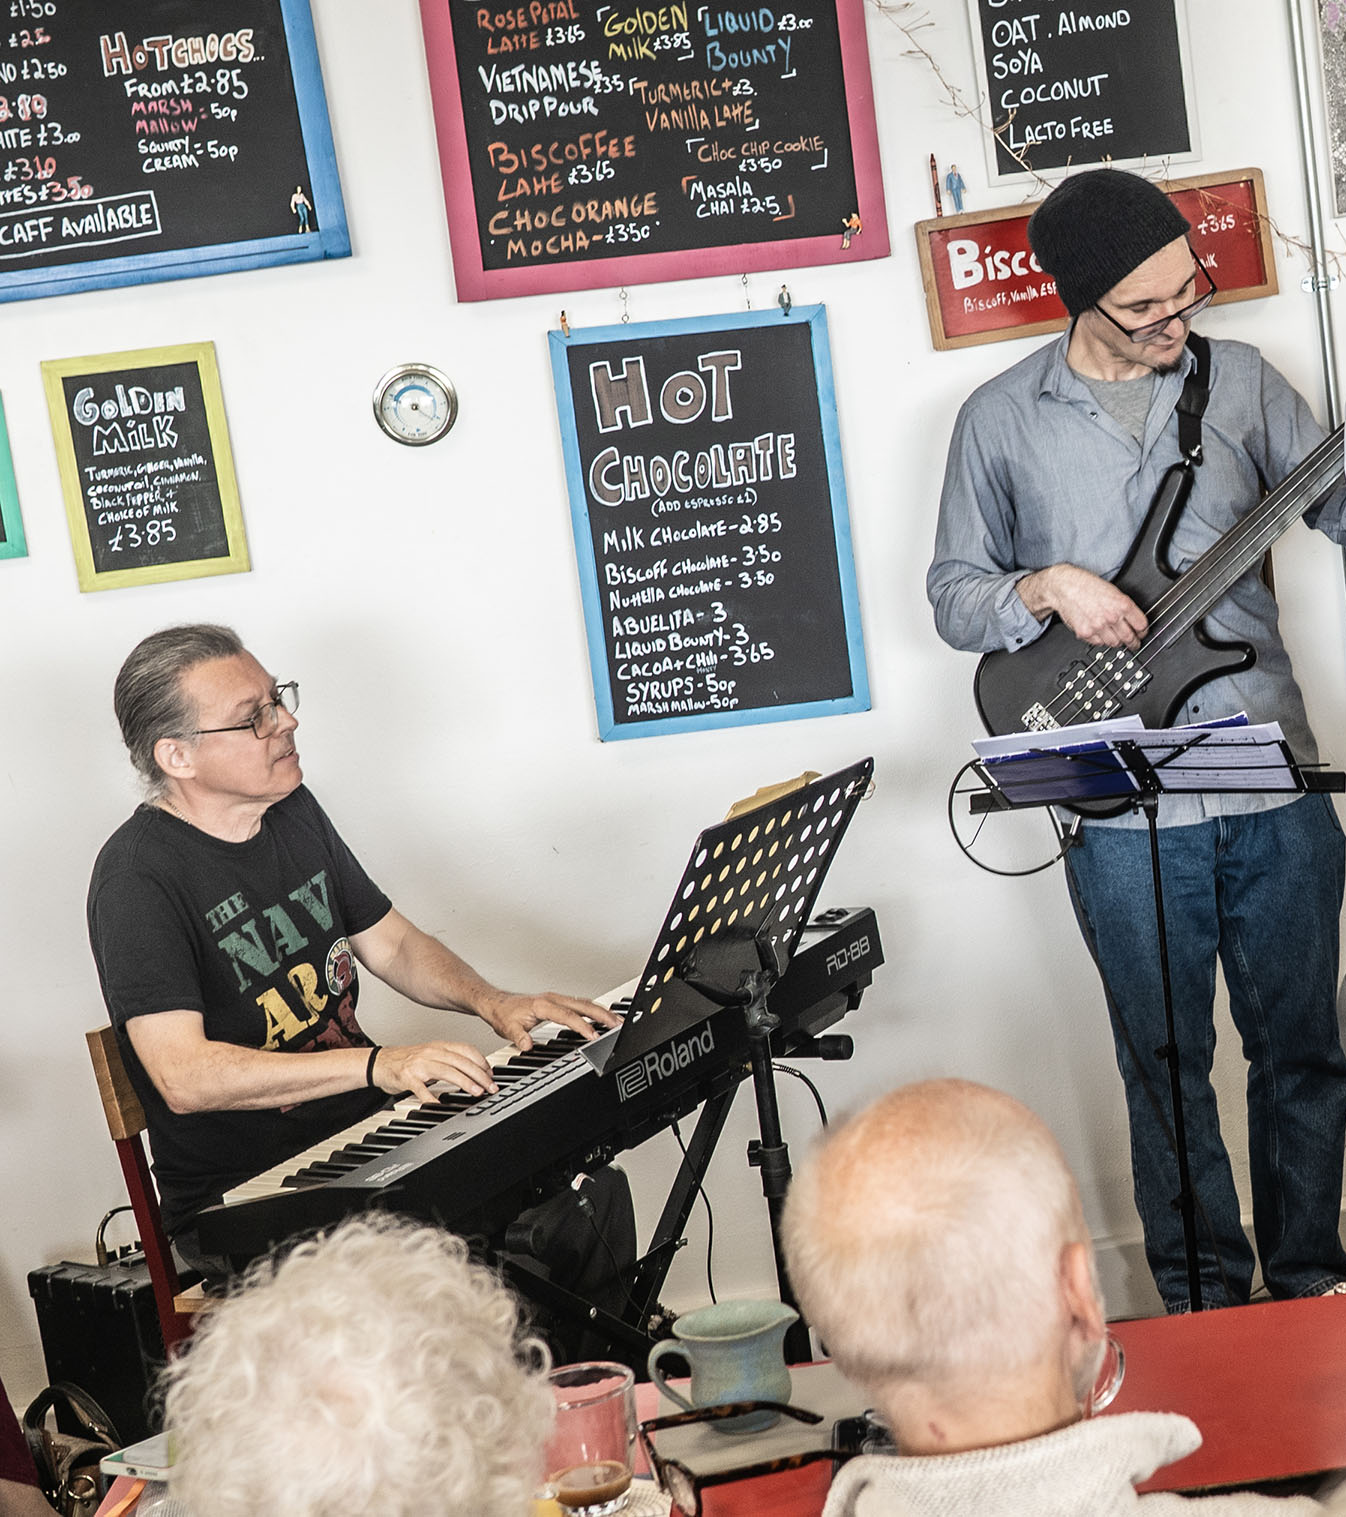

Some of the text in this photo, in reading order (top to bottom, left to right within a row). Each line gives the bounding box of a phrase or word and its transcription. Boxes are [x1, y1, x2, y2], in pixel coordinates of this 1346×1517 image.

[706, 35, 792, 73] BOUNTY
[478, 60, 603, 94] VIETNAMESE
[1000, 73, 1109, 110] COCONUT
[1009, 116, 1114, 150] LACTO FREE
[142, 155, 200, 174] CREAM
[487, 130, 637, 174] BISCOFFEE
[738, 157, 783, 173] £3.50
[567, 160, 616, 186] £3.65
[588, 432, 798, 508] CHOCOLATE
[108, 518, 177, 553] £3.85
[611, 607, 696, 638] ABUELITA
[204, 891, 250, 934] THE
[645, 1020, 715, 1087] Roland
